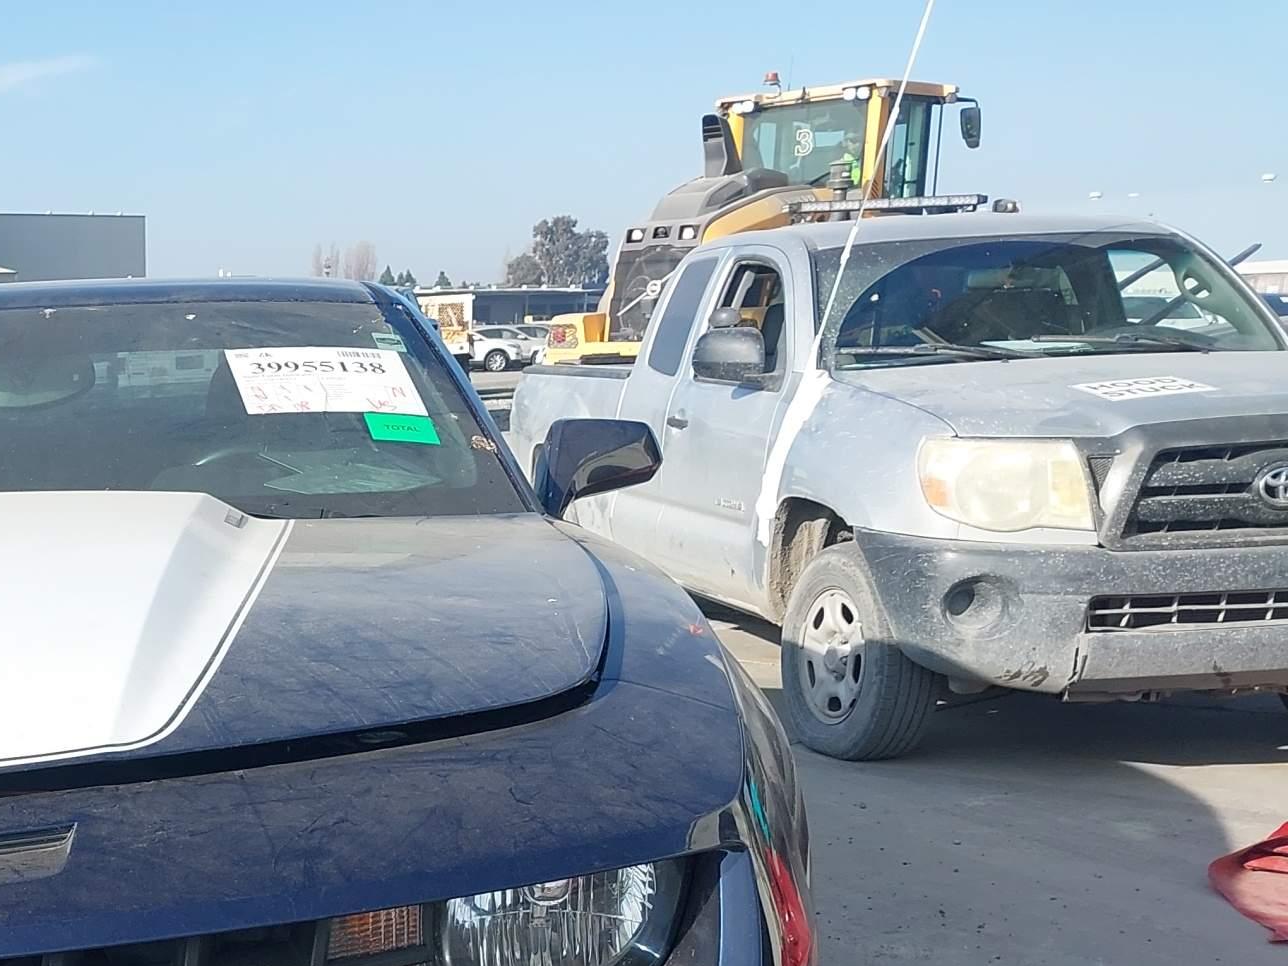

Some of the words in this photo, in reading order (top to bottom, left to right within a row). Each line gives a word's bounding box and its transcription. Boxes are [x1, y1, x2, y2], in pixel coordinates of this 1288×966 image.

[794, 129, 813, 156] 3
[249, 361, 387, 375] 39955138
[1085, 378, 1177, 390] HOOD
[1101, 383, 1195, 397] STUCK
[384, 424, 421, 433] TOTAL
